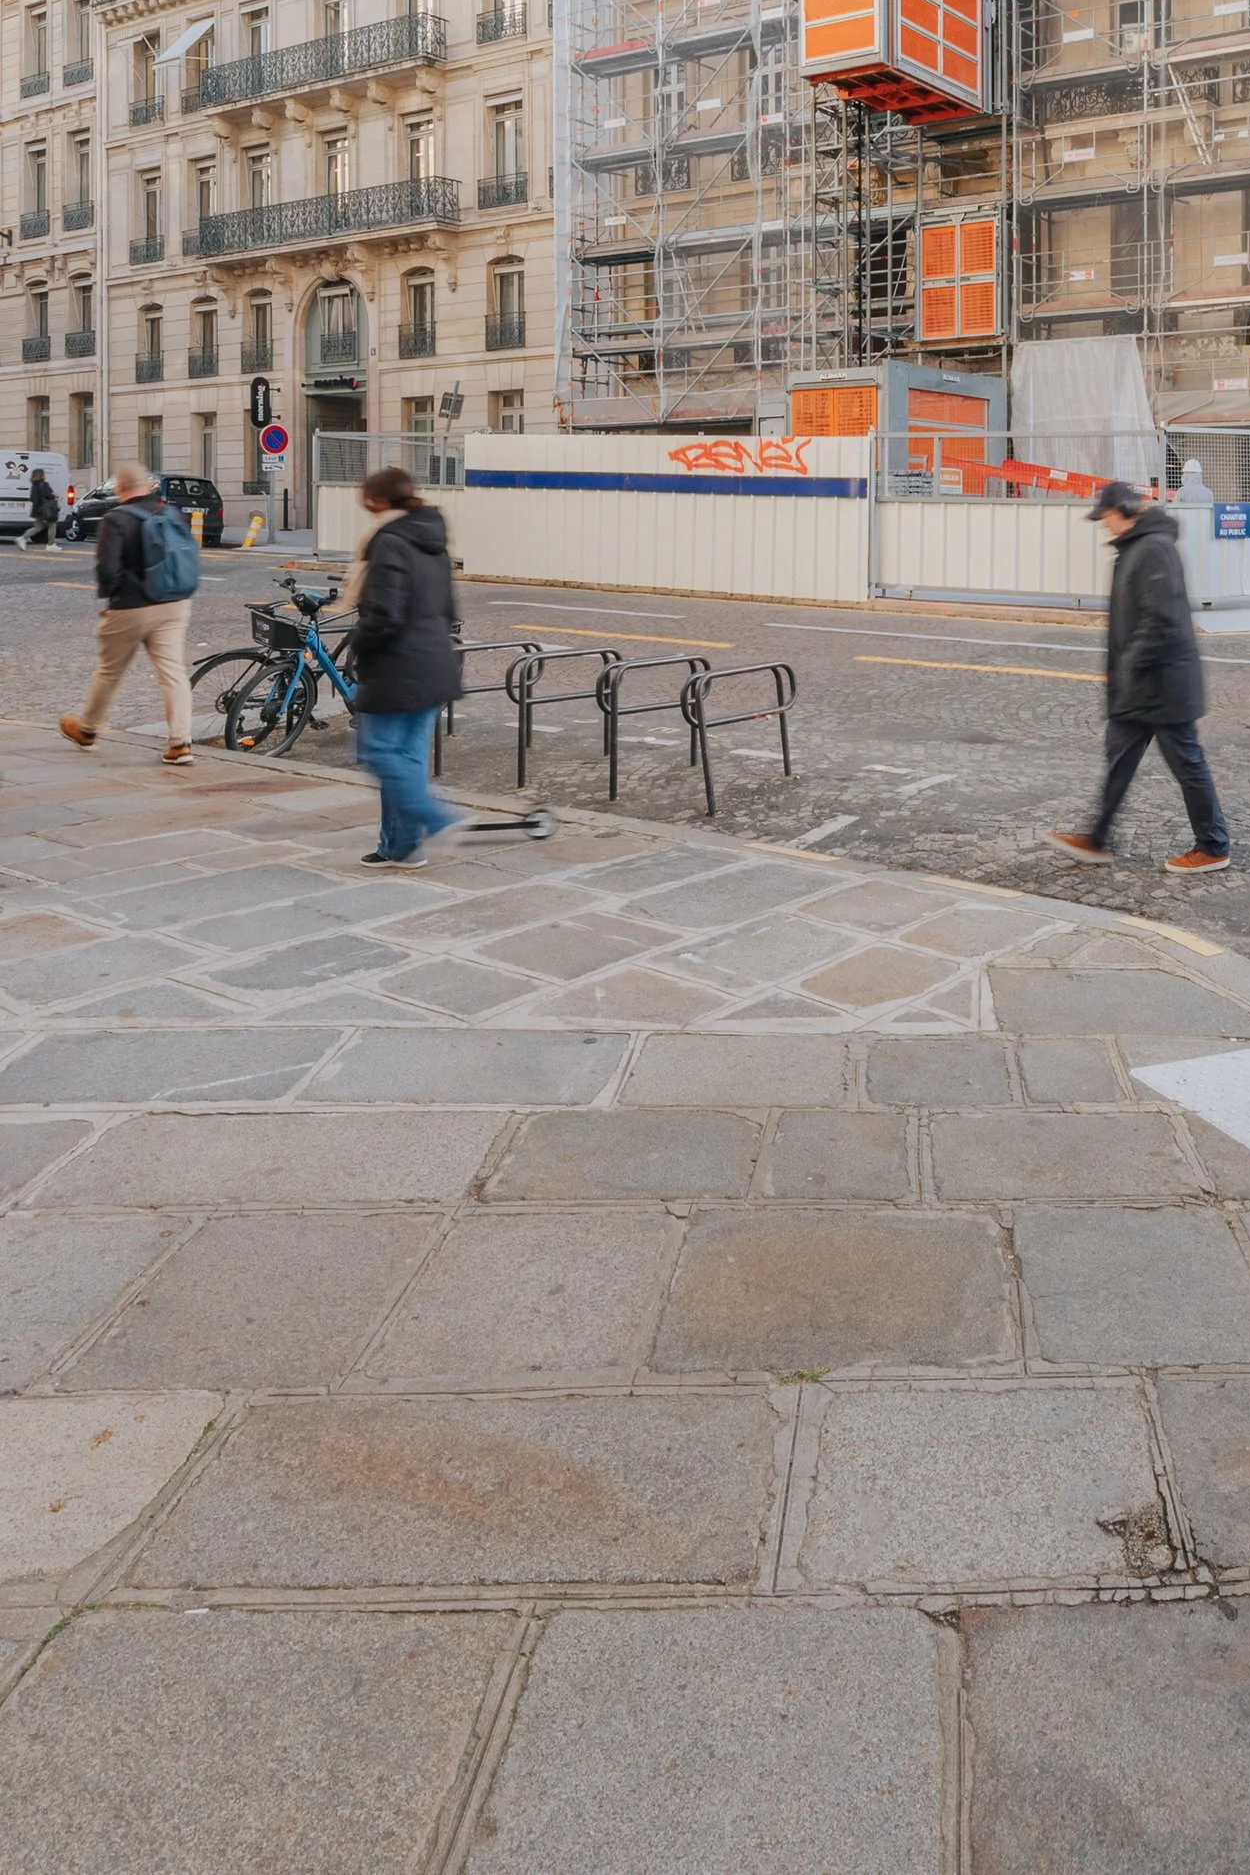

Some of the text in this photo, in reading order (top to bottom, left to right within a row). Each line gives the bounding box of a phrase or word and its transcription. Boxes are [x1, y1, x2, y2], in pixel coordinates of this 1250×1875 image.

[256, 385, 265, 421] morning
[1220, 513, 1247, 521] CHANTIER
[1219, 528, 1228, 536] AU
